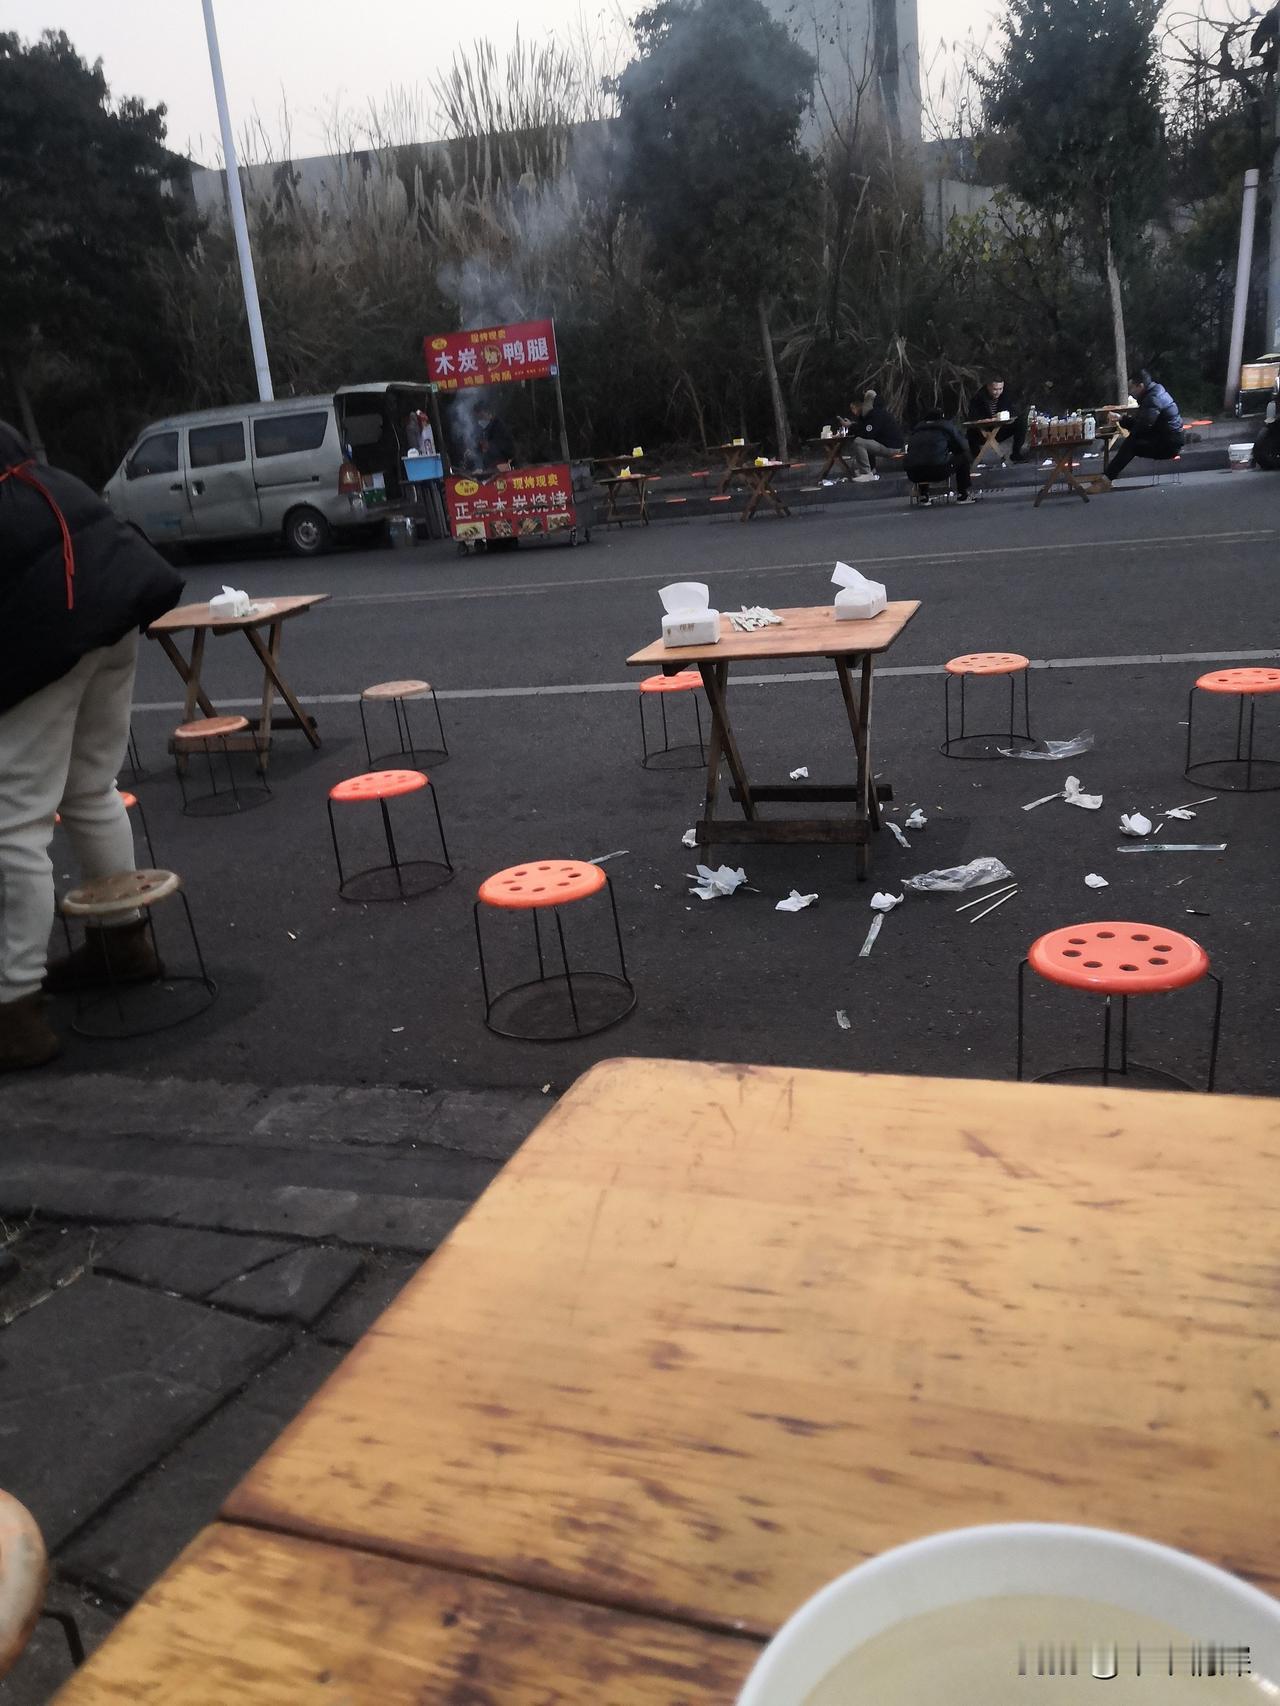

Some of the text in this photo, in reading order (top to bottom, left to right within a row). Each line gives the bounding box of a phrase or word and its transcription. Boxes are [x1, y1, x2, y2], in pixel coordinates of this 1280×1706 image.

[512, 474, 559, 489] 现烤现卖
[455, 490, 568, 520] 正宗木炭烧烤
